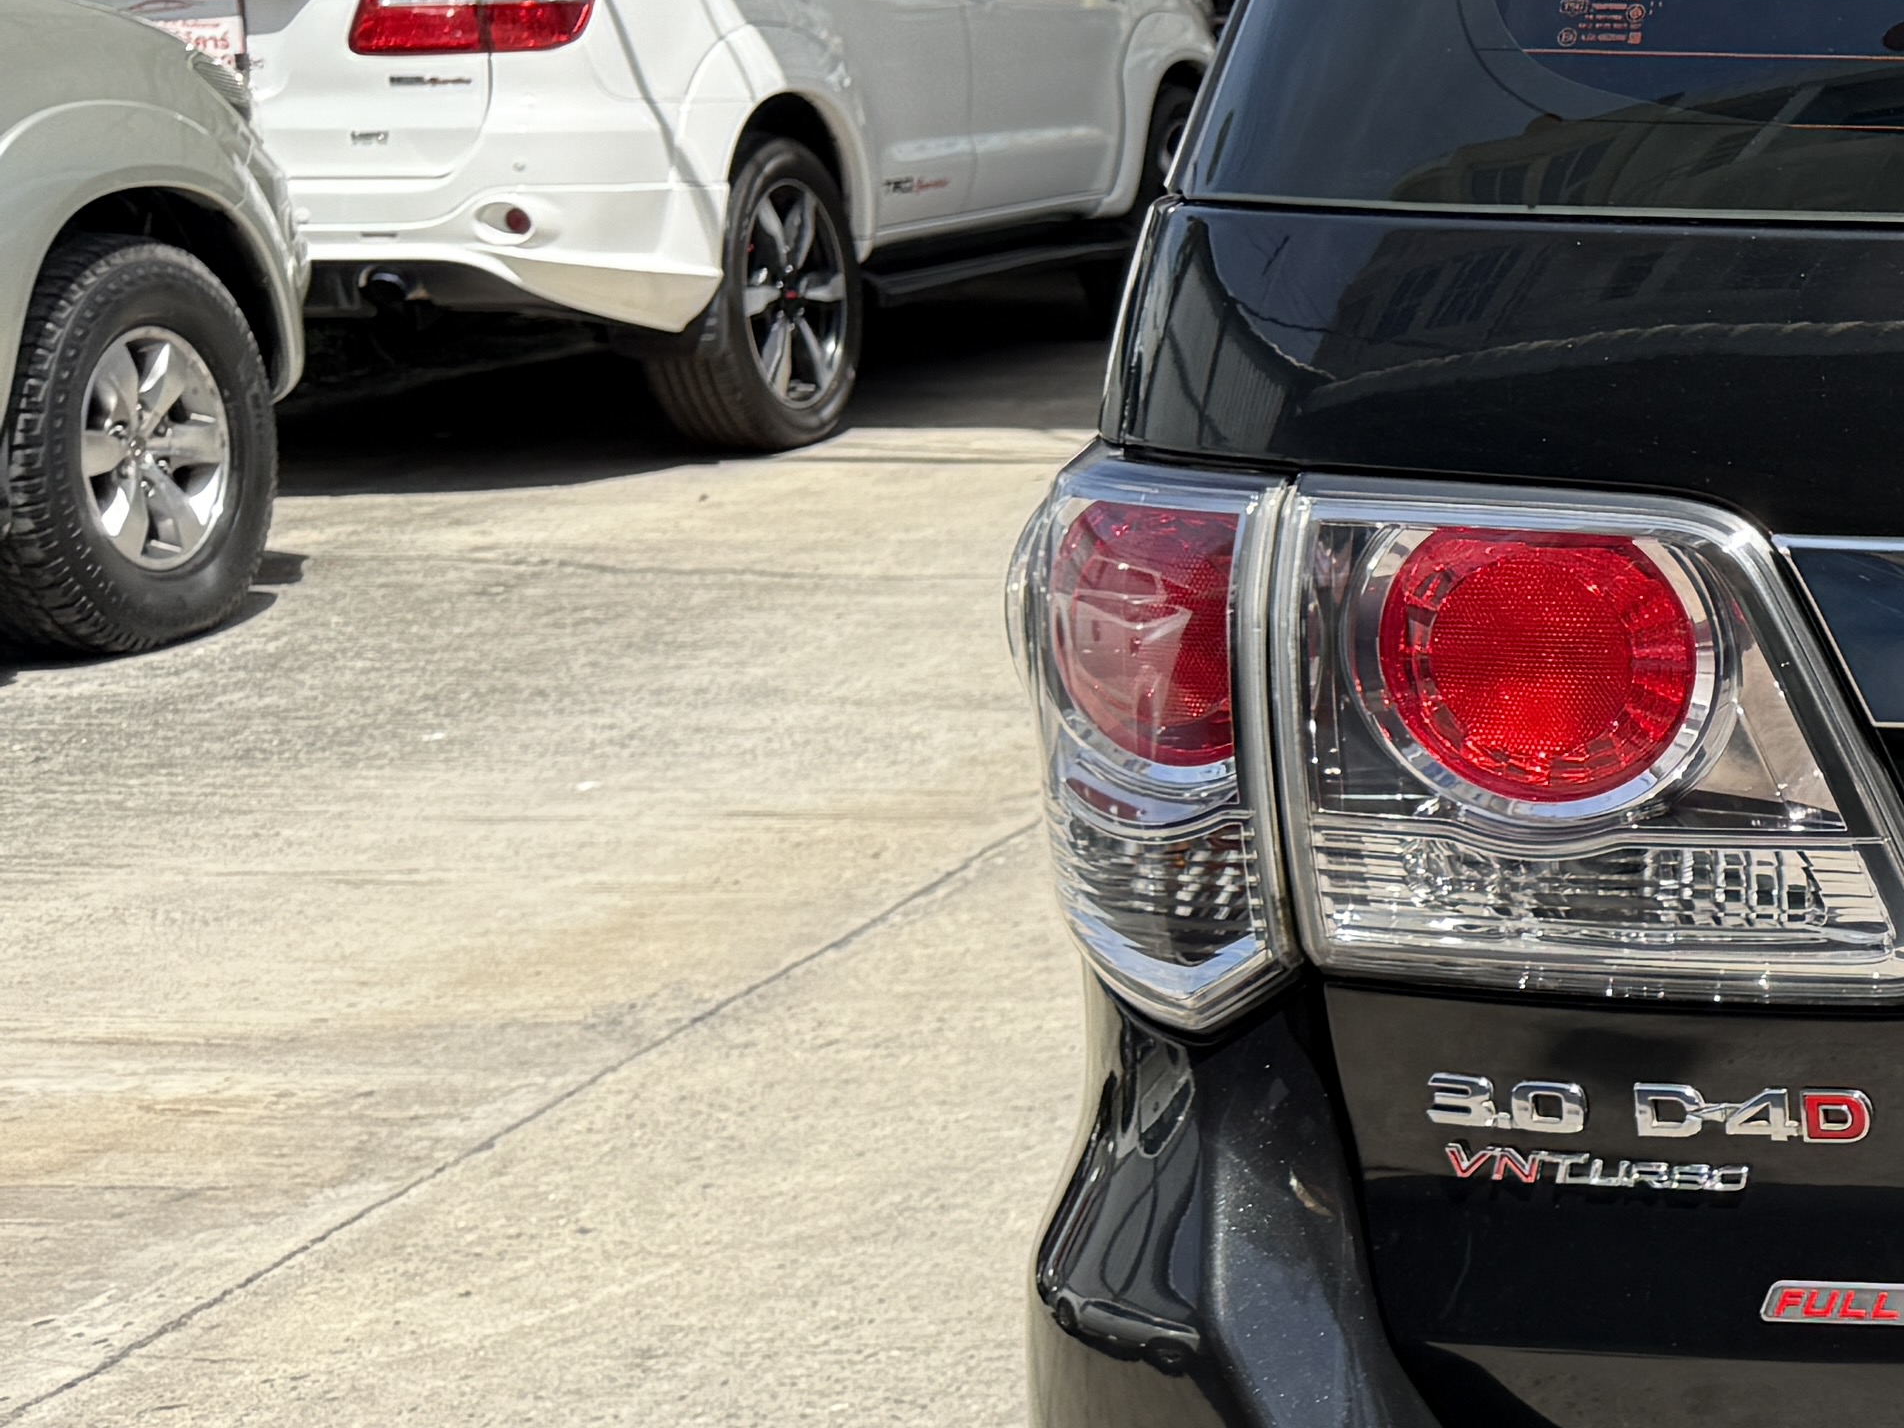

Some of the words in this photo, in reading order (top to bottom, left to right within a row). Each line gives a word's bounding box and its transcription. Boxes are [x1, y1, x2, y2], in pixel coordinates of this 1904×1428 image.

[1426, 1071, 1591, 1135] 3.0
[1634, 1082, 1873, 1143] D-4D
[1772, 1287, 1899, 1321] FULL
